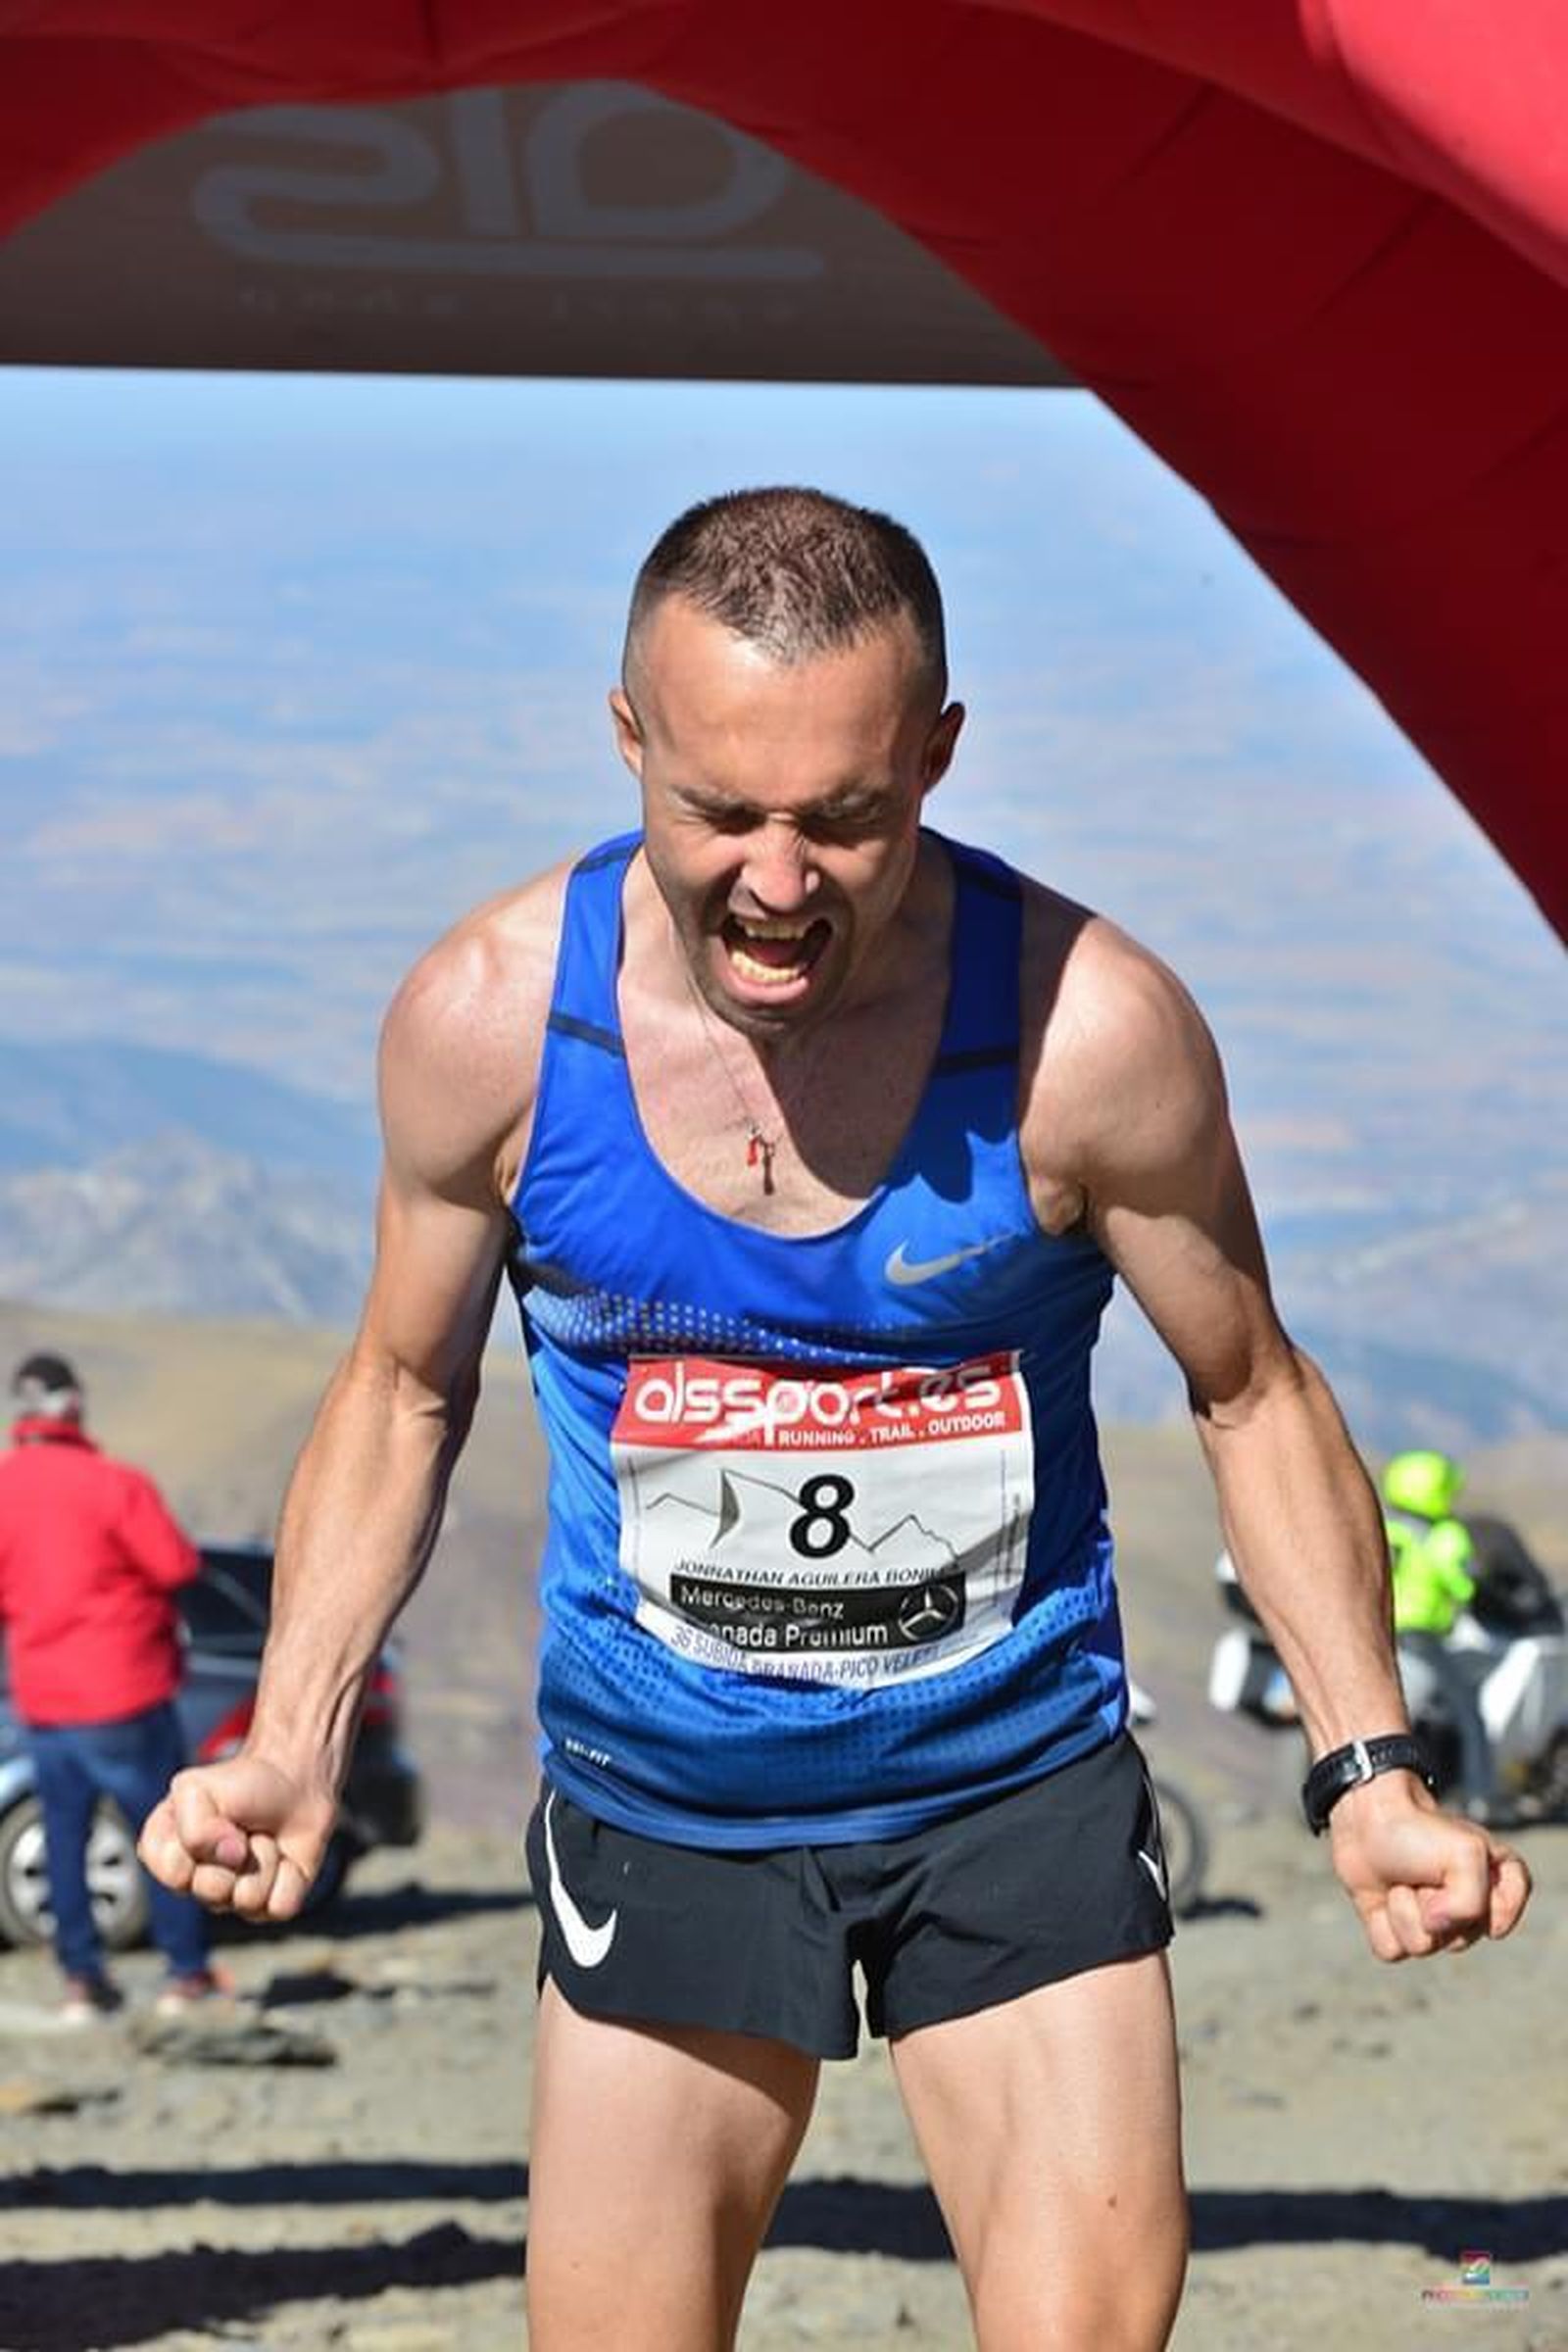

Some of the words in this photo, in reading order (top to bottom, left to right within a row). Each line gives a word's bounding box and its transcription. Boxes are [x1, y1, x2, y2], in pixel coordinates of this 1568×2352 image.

[778, 1431, 855, 1446] RUNNING
[870, 1424, 916, 1444] TRAIL
[928, 1411, 1005, 1435] OUTDOOR
[789, 1473, 855, 1559] 8
[680, 1585, 845, 1620] Mercedes-Benz
